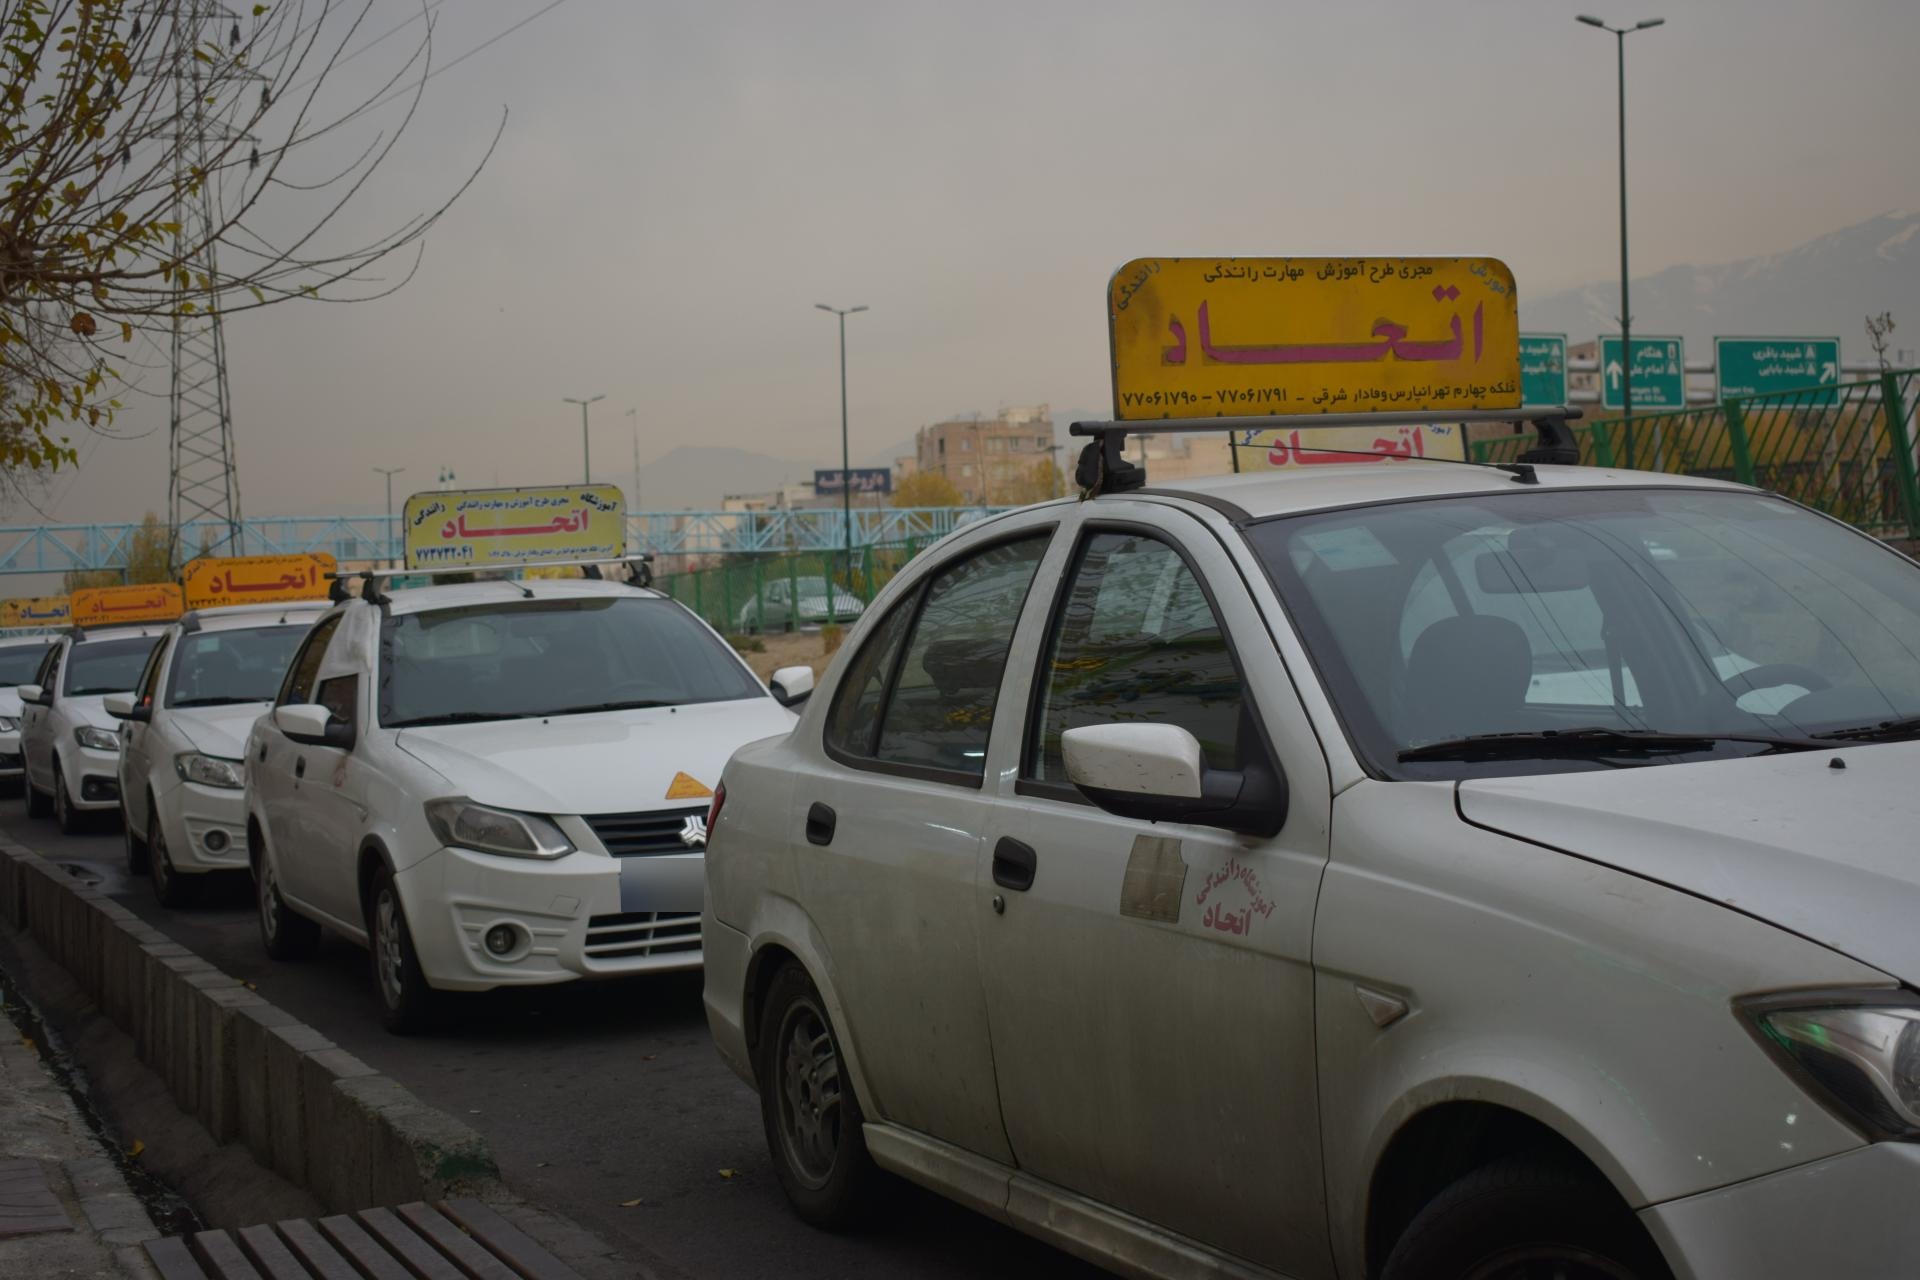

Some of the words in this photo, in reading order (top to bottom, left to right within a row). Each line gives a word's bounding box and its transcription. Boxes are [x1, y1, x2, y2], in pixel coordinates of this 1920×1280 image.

[1203, 265, 1259, 283] رانندگی
[1263, 264, 1304, 282] مهارت
[1316, 261, 1365, 282] آموزش
[1369, 264, 1394, 283] طرح
[1399, 264, 1433, 279] مجری
[1163, 284, 1484, 366] اتحاد
[1312, 387, 1347, 405] شرقی
[1454, 383, 1487, 400] چهارم
[1489, 380, 1516, 395] فلکه
[1268, 426, 1424, 466] اتحاد
[441, 507, 588, 539] اتحاد
[209, 564, 317, 593] اتحاد
[91, 596, 166, 613] اتحاد
[1203, 901, 1252, 936] اتحاد
